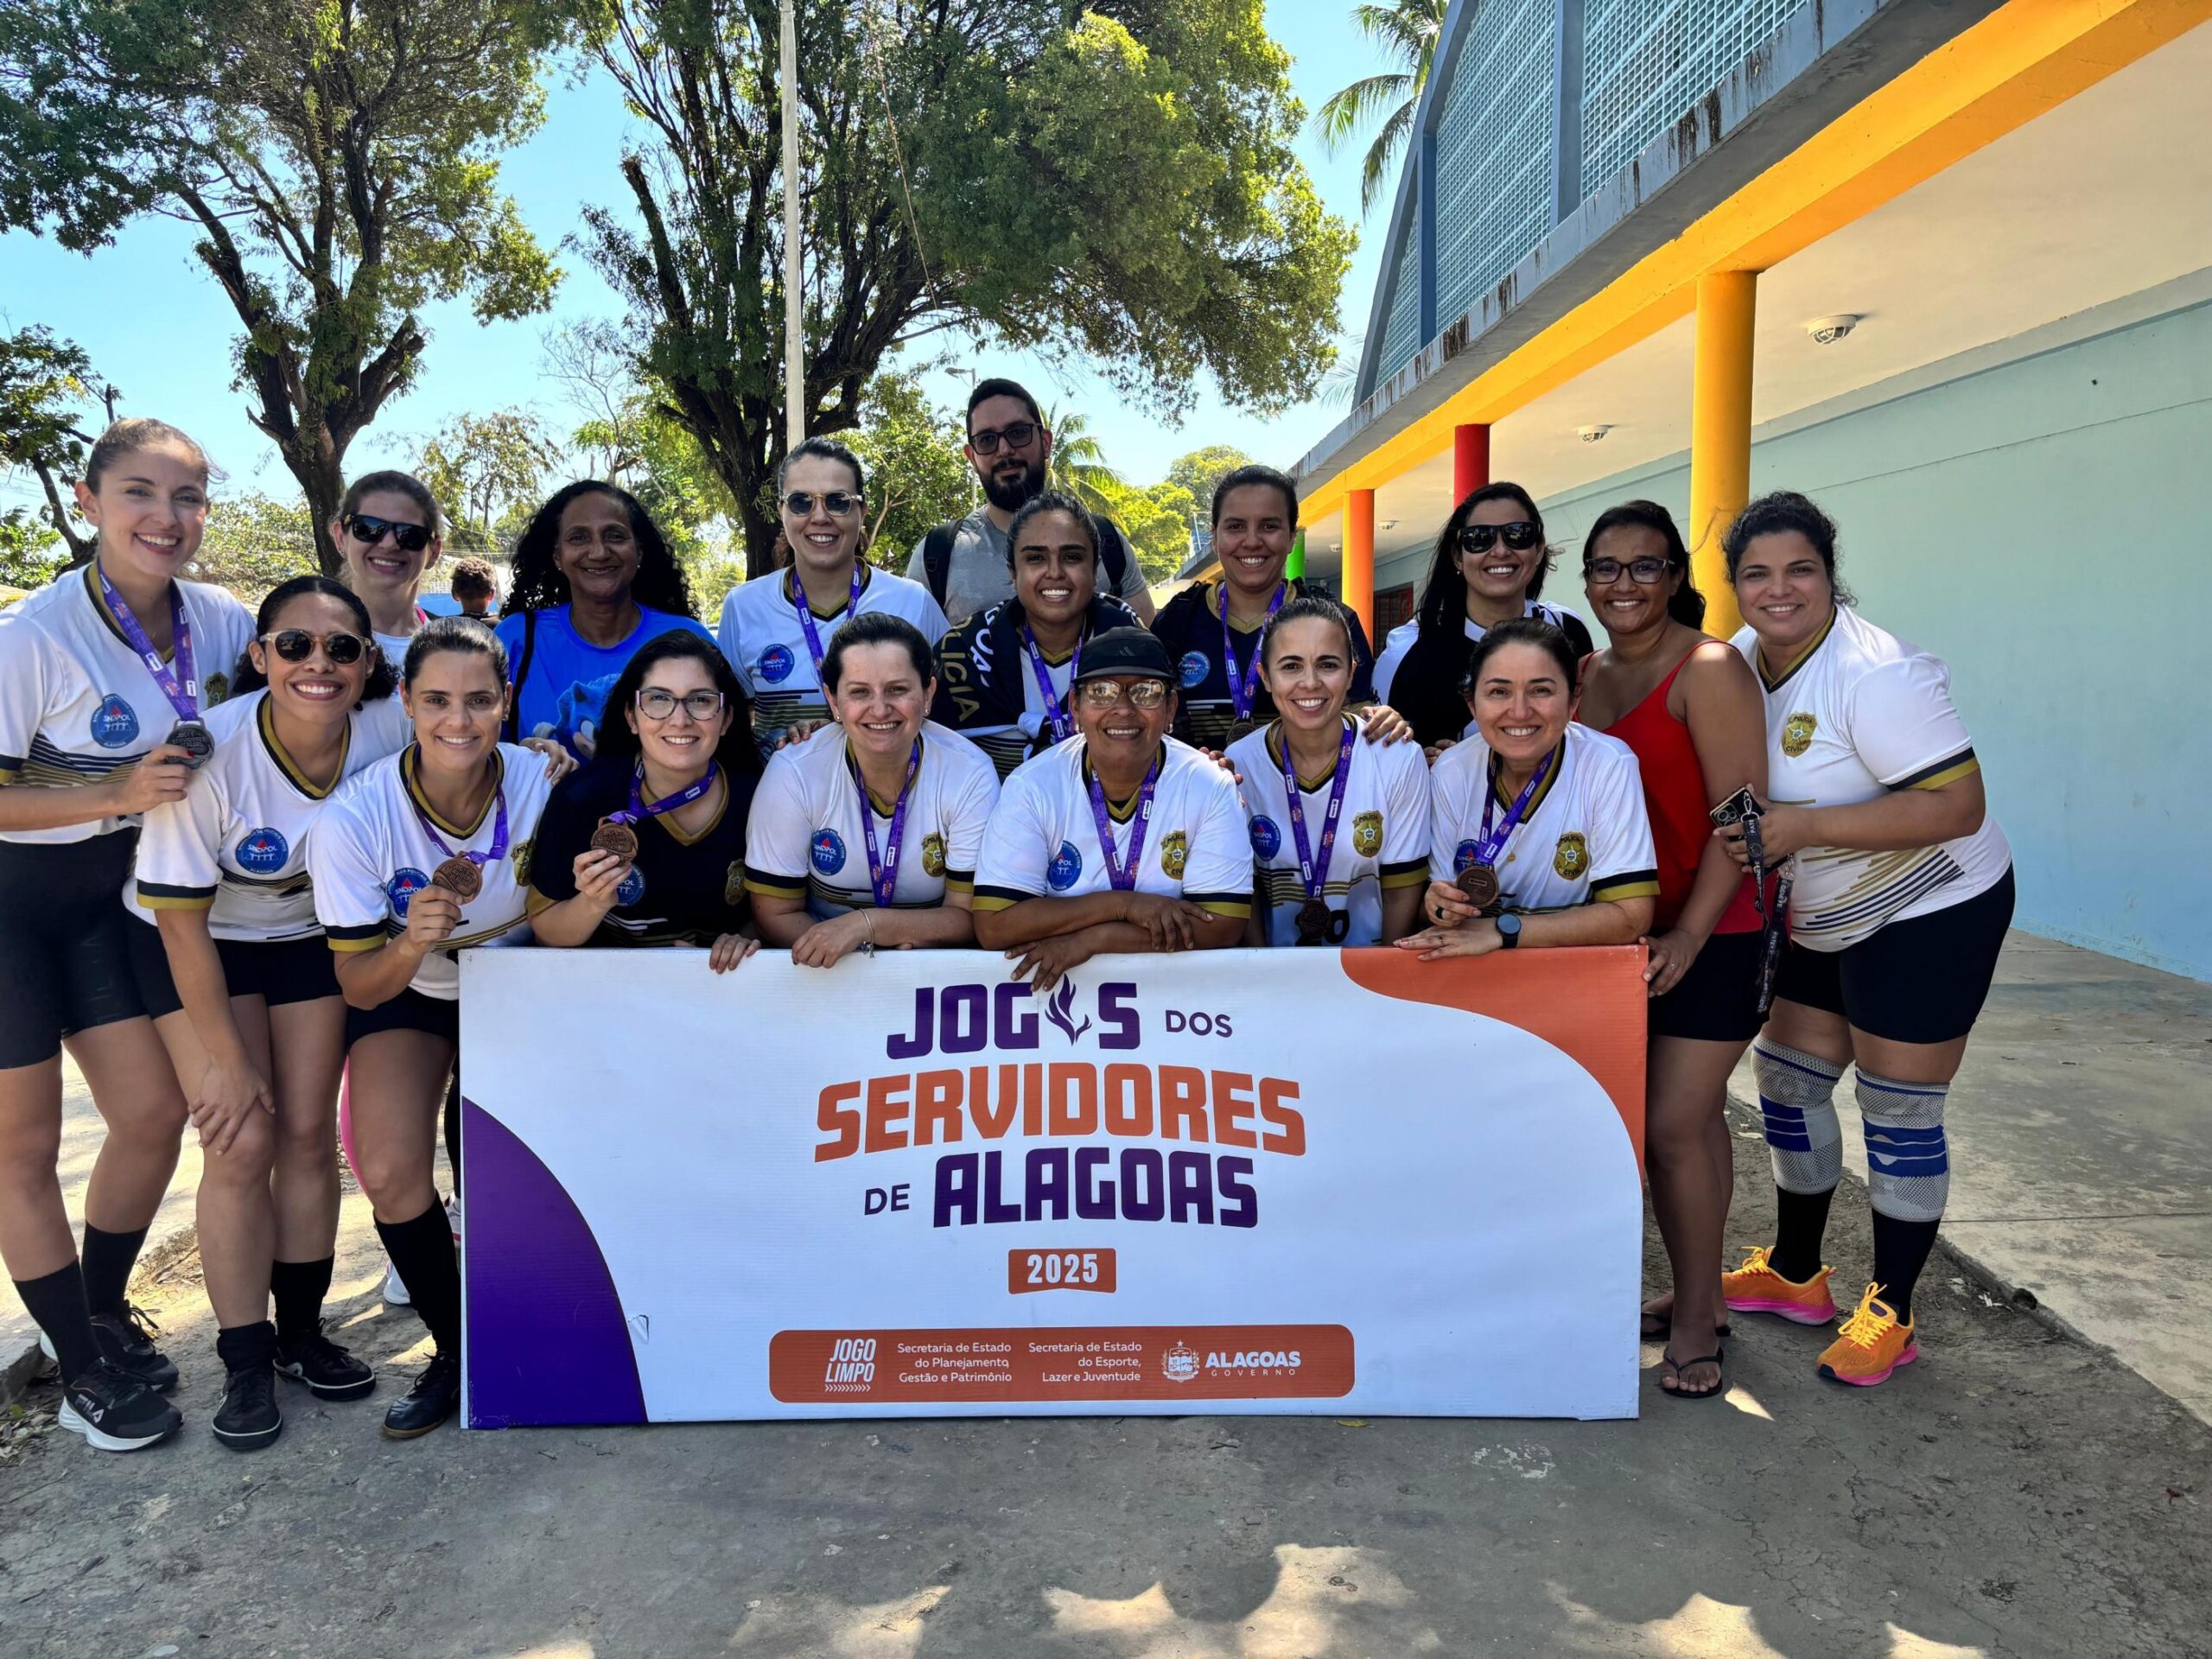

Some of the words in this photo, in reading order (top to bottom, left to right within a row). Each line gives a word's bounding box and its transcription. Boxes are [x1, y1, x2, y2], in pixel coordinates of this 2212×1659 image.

[1165, 1009, 1233, 1038] DOS
[814, 1062, 1306, 1162] SERVIDORES
[864, 1183, 910, 1215] DE
[933, 1147, 1258, 1228] ALAGOAS
[1027, 1254, 1098, 1283] 2025
[830, 1338, 877, 1362] JOGO
[897, 1343, 953, 1353] Secretaria
[955, 1343, 969, 1353] de
[972, 1342, 1012, 1352] Estado
[1028, 1342, 1084, 1352] Secretaria
[1086, 1342, 1101, 1352] de
[1103, 1341, 1142, 1351] Estado
[914, 1358, 930, 1368] do
[1077, 1357, 1092, 1367] do
[1096, 1357, 1141, 1368] Esporte,
[1205, 1351, 1301, 1369] ALAGOAS
[825, 1363, 875, 1382] LIMPO
[899, 1372, 938, 1382] Gestão
[950, 1372, 1013, 1382] Patrimônio
[1042, 1372, 1072, 1382] Lazer
[1082, 1371, 1141, 1382] Juventude
[1211, 1369, 1296, 1377] GOVERNO
